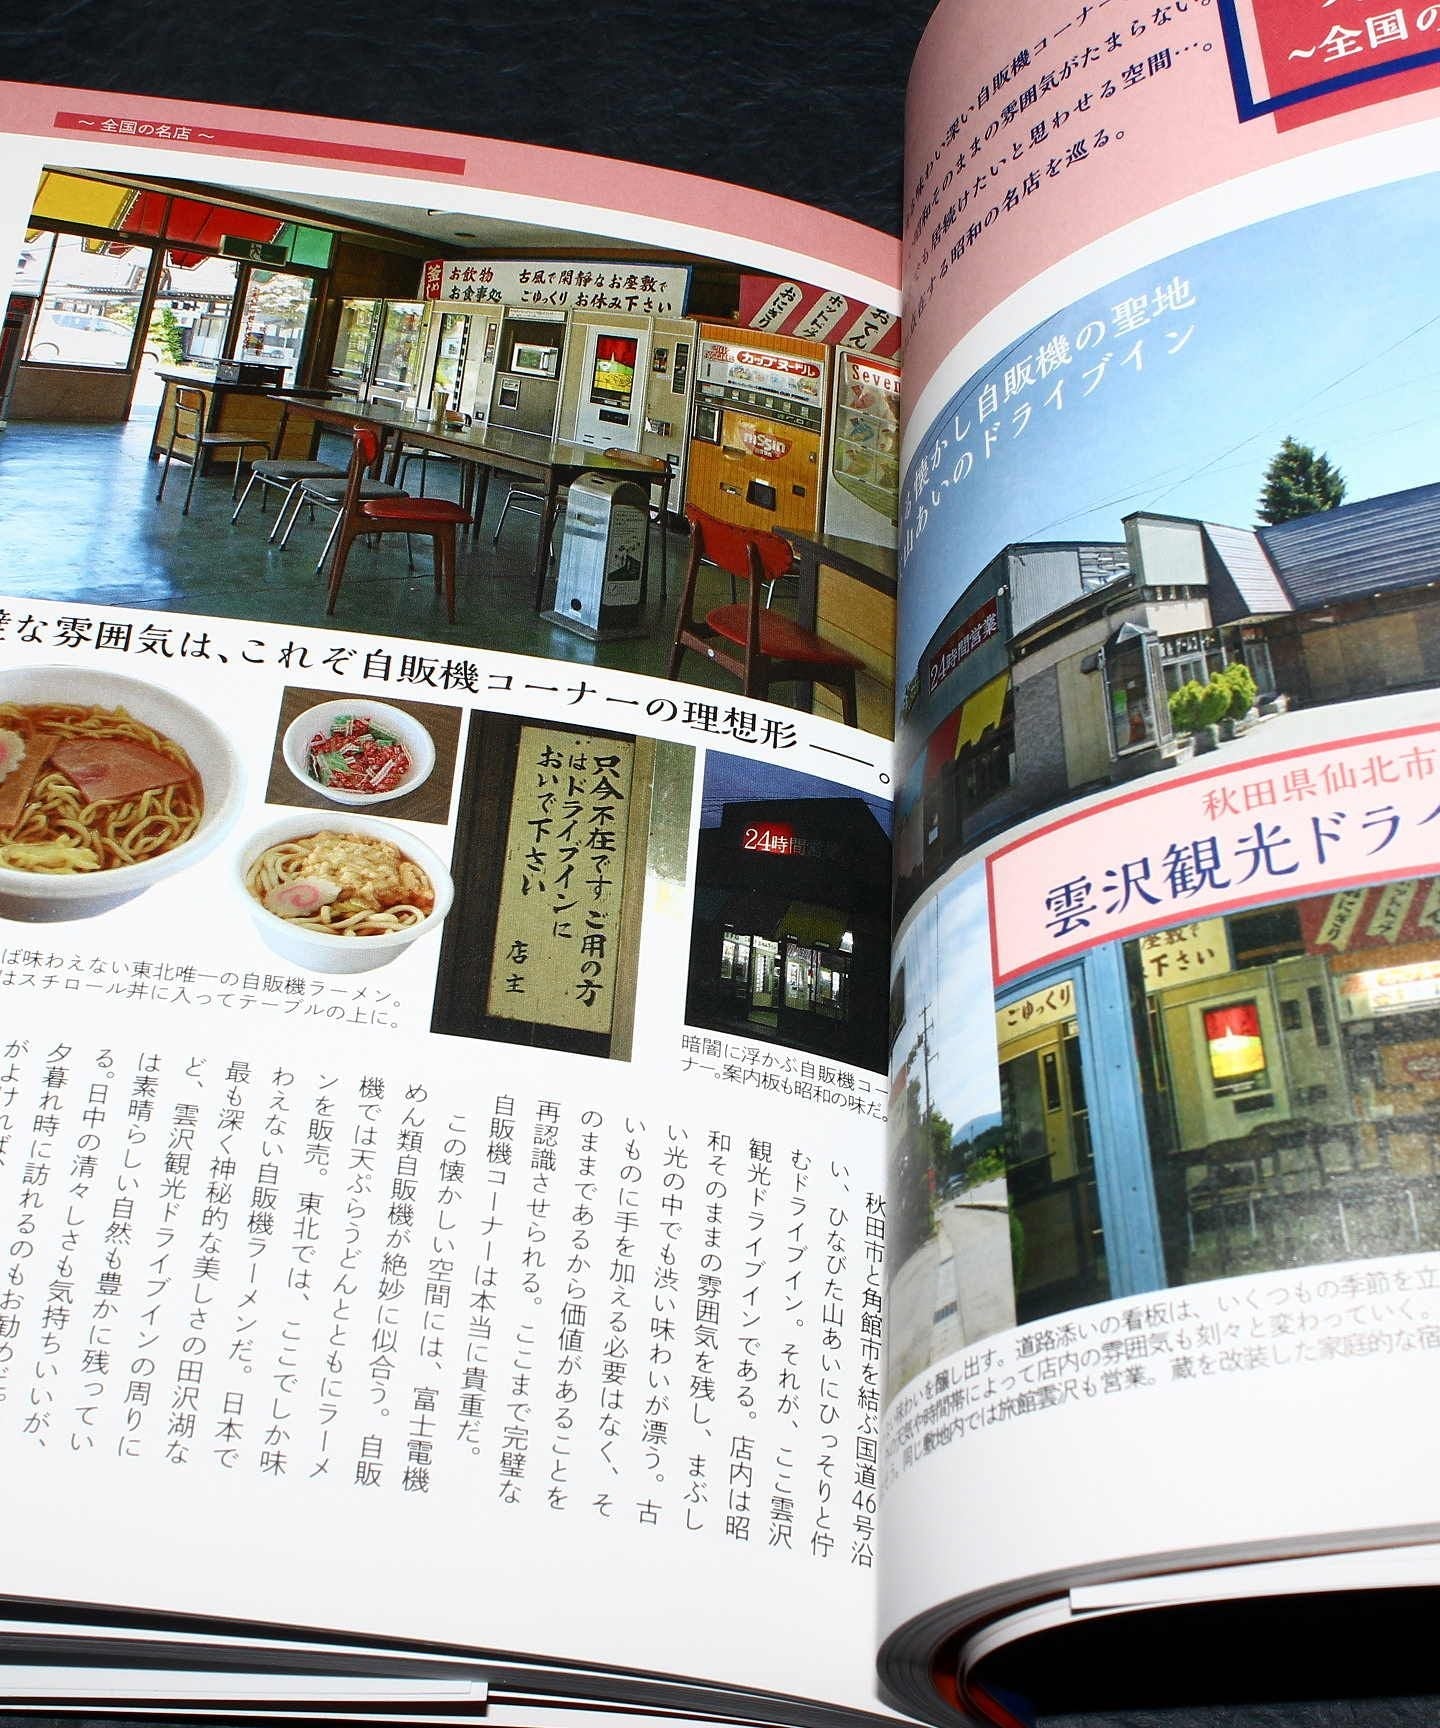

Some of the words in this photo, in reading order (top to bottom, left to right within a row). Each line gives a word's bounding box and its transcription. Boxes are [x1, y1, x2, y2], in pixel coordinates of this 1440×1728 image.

[905, 275, 1196, 520] 懐かし自販機の聖地
[506, 940, 528, 994] 店主
[521, 744, 565, 897] おいで下さい
[551, 753, 588, 940] はドライブインに
[1201, 746, 1437, 822] 秋田県仙北市
[24, 1050, 114, 1446] る。日中の清々しさも気持ちいいが、
[72, 1053, 161, 1450] は素晴らしい自然も豊かに残ってい
[119, 1057, 206, 1456] ど、雲沢観光ドライブインの周りに
[166, 1061, 251, 1463] 最も深く神秘的な美しさの田沢湖な
[682, 1034, 889, 1095] 暗闇に浮かぶ自販機コー
[214, 1067, 294, 1468] わえない自販機ラーメンだ。日本で
[260, 1075, 338, 1475] ンを販売。東北では、ここでしか味
[310, 1076, 384, 1477] 機では天ぷらうどんとともにラーメ
[355, 1084, 427, 1487] めん類自販機が絶妙に似合う。自販
[402, 1115, 466, 1493] この懐かしい空間には、富士電機
[457, 1095, 515, 1454] 自販機コーナーは本当に貴重だ。
[499, 1101, 560, 1503] 再認識させられる。ここまで完璧な
[548, 1111, 602, 1510] のままであるから価値があることを
[593, 1118, 645, 1517] いものに手を加える必要はなく、そ
[637, 1125, 688, 1525] い光の中でも渋い味わいが漂う。古
[684, 1131, 730, 1530] 和そのままの雰囲気を残し、まぶし
[726, 1138, 772, 1541] 観光ドライブインである。店内は昭
[769, 1149, 811, 1549] むドライブイン。それが、ここ雲沢
[811, 1161, 849, 1557] い、ひなびた山あいにひっそりと佇
[851, 1193, 886, 1568] 秋田市と角館市を結ぶ国道46号沿
